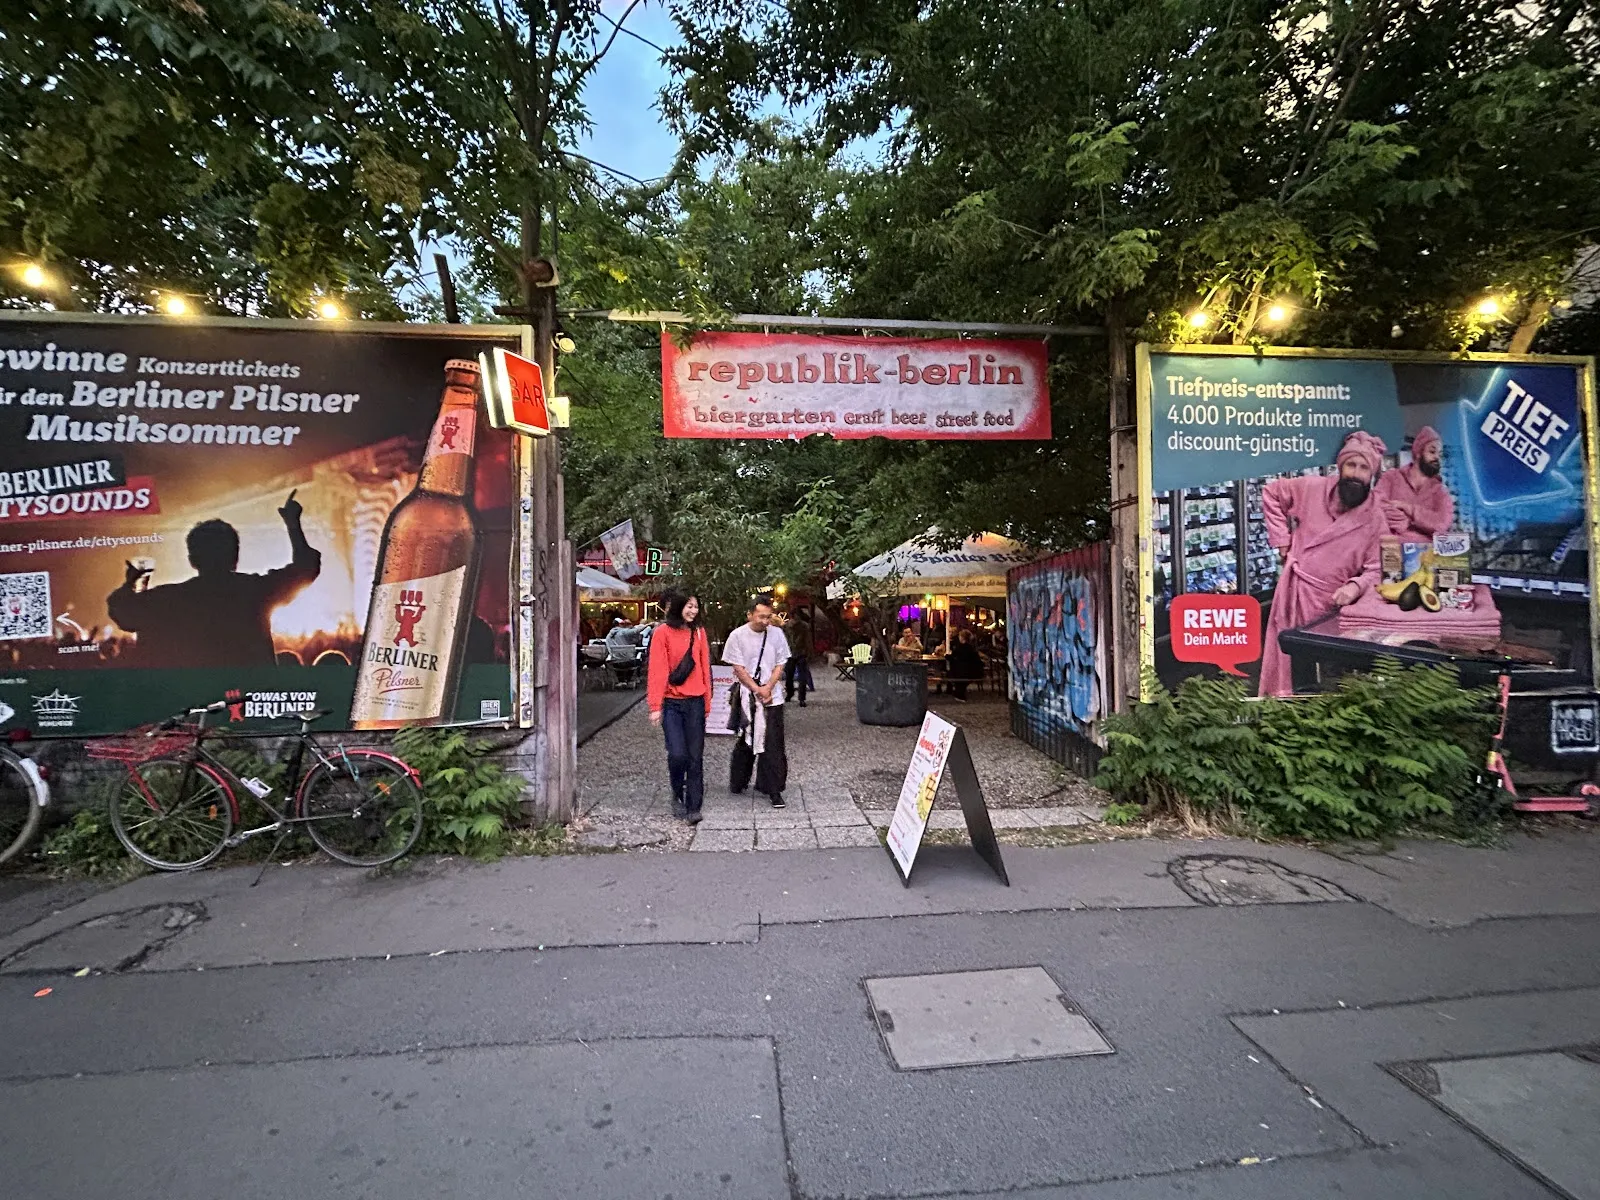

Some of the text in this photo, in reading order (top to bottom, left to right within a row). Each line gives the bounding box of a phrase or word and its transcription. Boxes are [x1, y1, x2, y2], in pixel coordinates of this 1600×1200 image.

[0, 342, 301, 379] winne Konzerttickets
[688, 351, 1025, 390] republik-berlin
[20, 388, 65, 406] den
[69, 380, 225, 410] Berliner
[229, 384, 360, 413] Pilsner
[508, 373, 546, 412] BAR
[1166, 375, 1351, 403] Tiefpreis-entspannt:
[693, 405, 1015, 428] biergarten craft beer street food
[1167, 404, 1363, 428] 4.000 Produkte immer
[1499, 379, 1570, 446] TIEF
[26, 414, 301, 446] Musiksommer
[1167, 430, 1320, 457] discount-günstig.
[1489, 417, 1543, 468] PREIS
[0, 459, 116, 495] BERLINER
[911, 553, 988, 565] Spalter
[1183, 608, 1248, 629] REWE
[58, 645, 80, 654] scan
[1183, 631, 1248, 646] Dein Markt
[367, 641, 439, 672] BERLINER
[373, 667, 421, 691] Pilsner
[289, 691, 317, 702] VON
